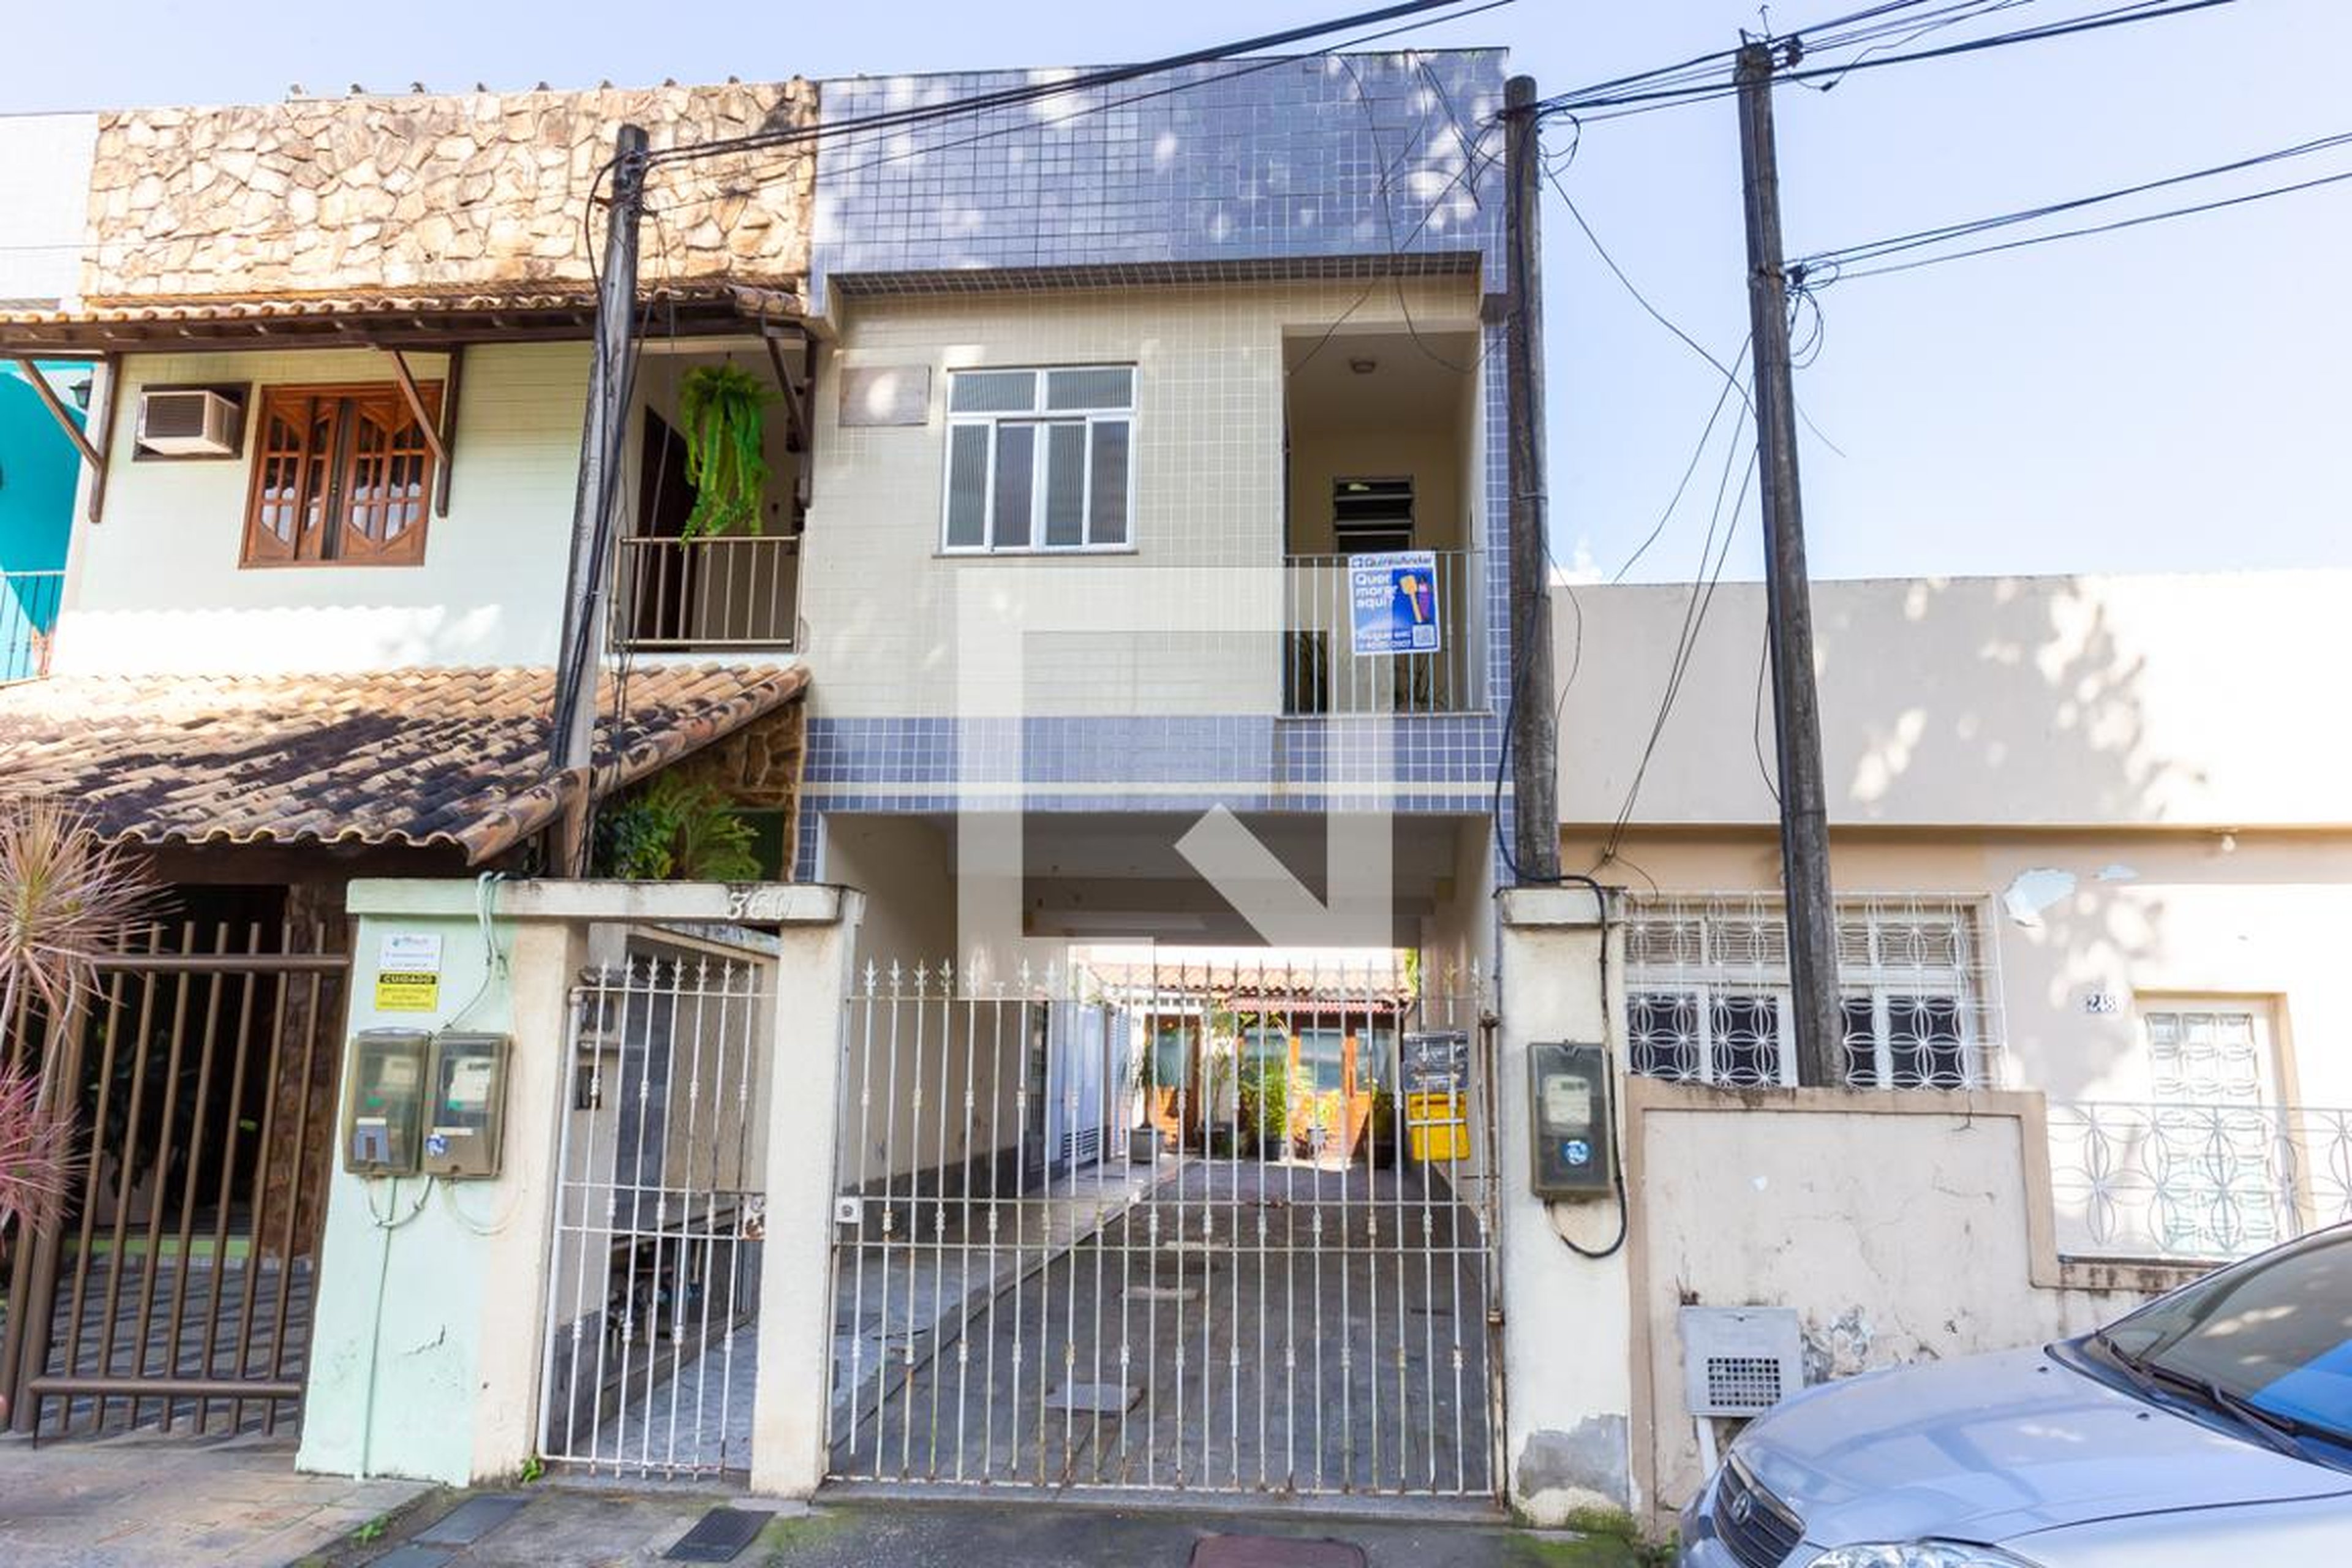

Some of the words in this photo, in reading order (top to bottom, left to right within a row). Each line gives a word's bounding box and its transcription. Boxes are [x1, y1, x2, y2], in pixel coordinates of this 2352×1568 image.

[1355, 573, 1392, 586] Quer
[1355, 585, 1398, 598] morar
[383, 974, 432, 984] CUIDADO
